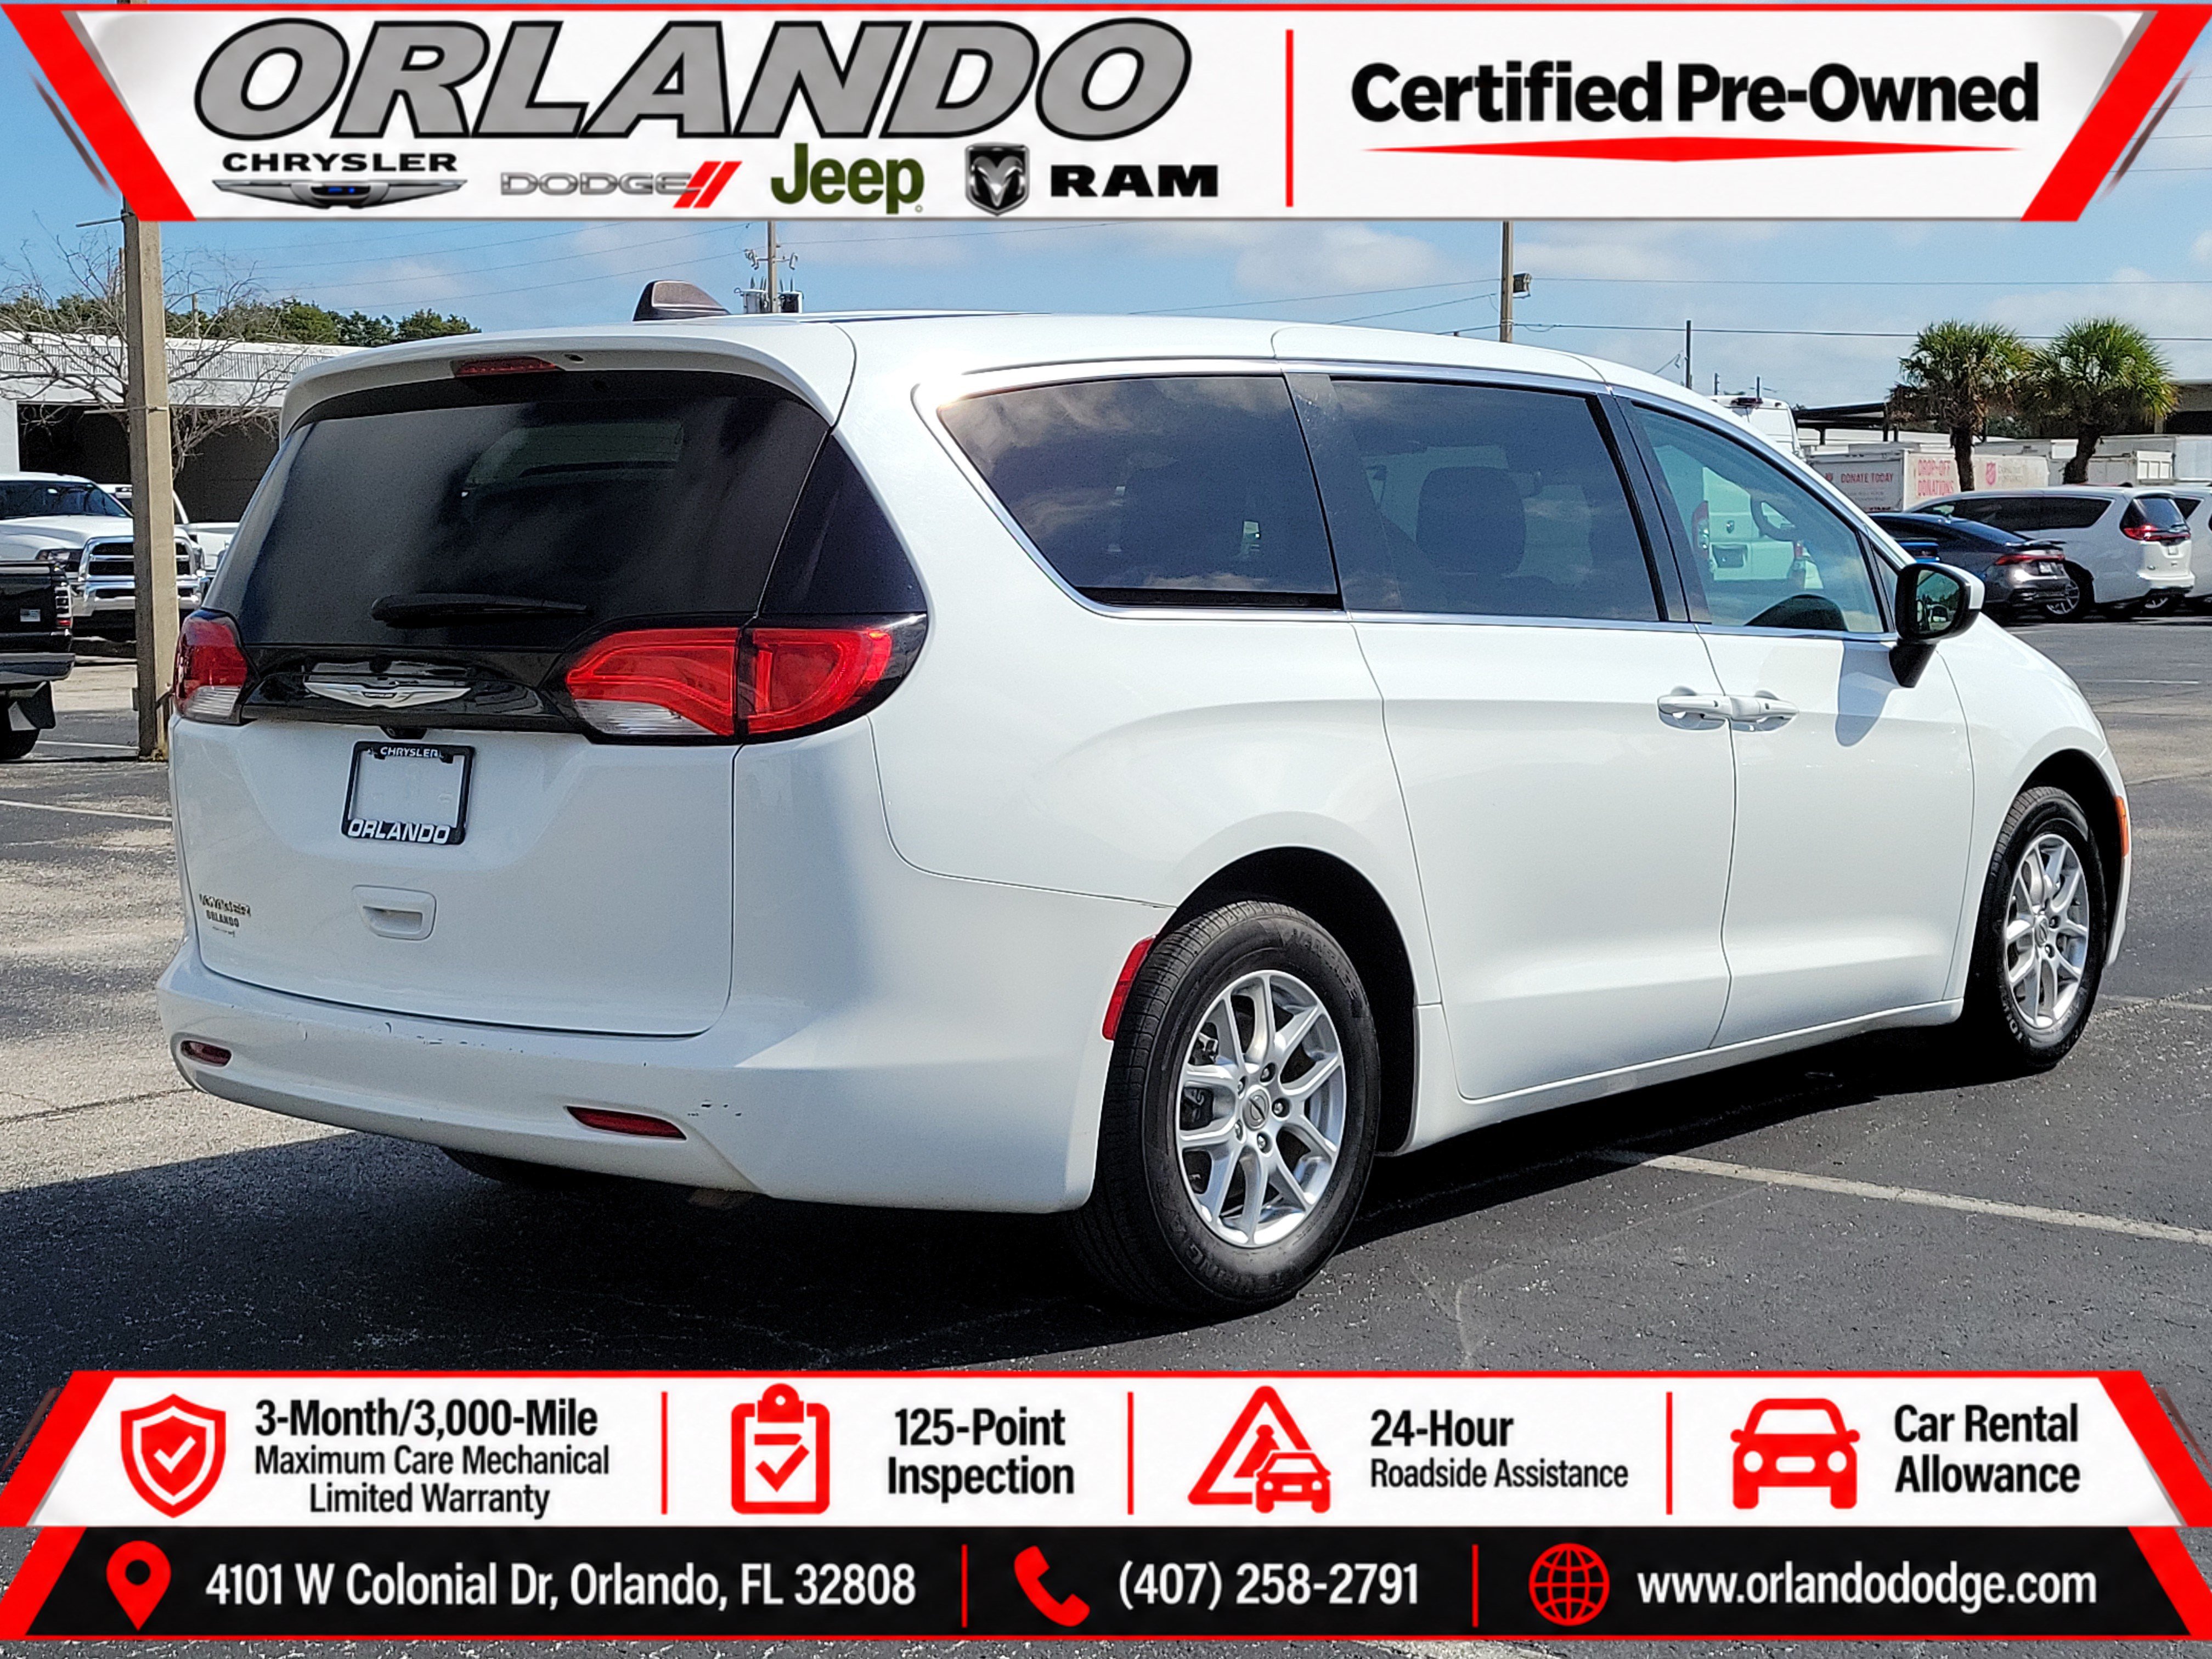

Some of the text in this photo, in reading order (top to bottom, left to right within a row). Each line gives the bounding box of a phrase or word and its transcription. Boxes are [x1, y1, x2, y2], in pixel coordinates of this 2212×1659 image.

[1841, 472, 1893, 483] DONATE TODAY
[1917, 481, 1954, 496] DONATIONS
[380, 746, 439, 758] CHRYSLER
[347, 819, 451, 844] ORLANDO
